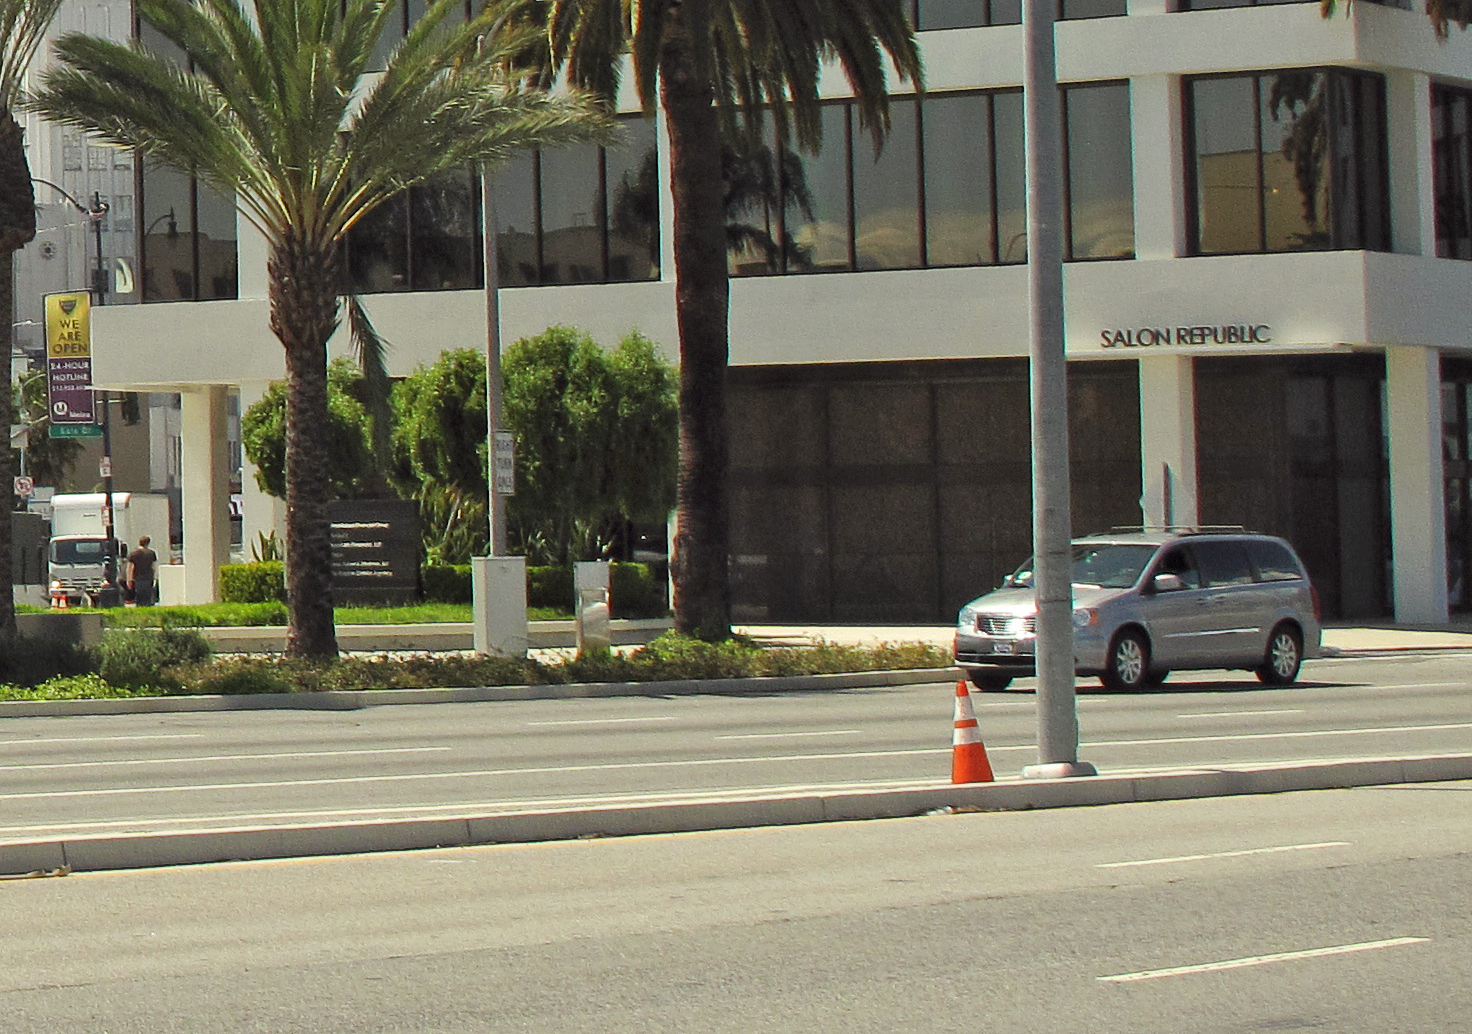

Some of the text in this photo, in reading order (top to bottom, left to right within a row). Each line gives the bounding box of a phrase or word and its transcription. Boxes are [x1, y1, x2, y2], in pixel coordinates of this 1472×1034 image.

[59, 319, 80, 330] WE
[57, 331, 82, 342] ARE
[1100, 324, 1272, 348] SALON REPUBLIC
[52, 342, 88, 354] OPEN
